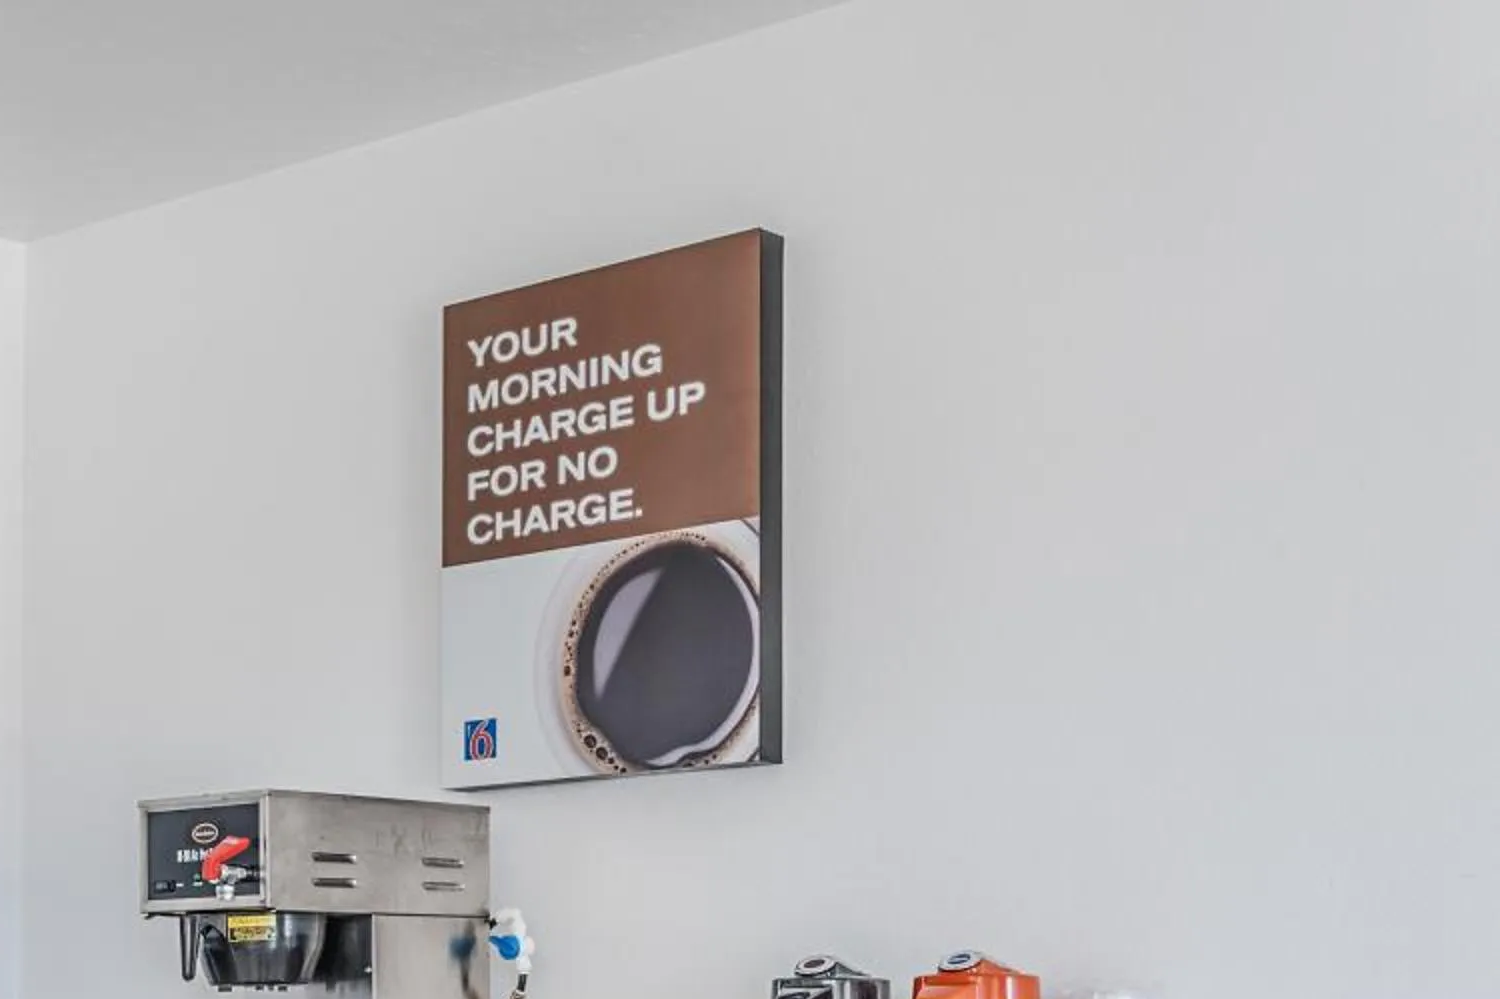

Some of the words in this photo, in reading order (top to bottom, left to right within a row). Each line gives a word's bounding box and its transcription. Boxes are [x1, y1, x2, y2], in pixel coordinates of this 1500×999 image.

[467, 316, 579, 369] YOUR
[467, 343, 664, 414] MORNING
[466, 395, 636, 458] CHARGE
[647, 380, 707, 423] UP
[467, 460, 547, 501] FOR
[558, 445, 618, 486] NO
[466, 488, 643, 547] CHARGE.
